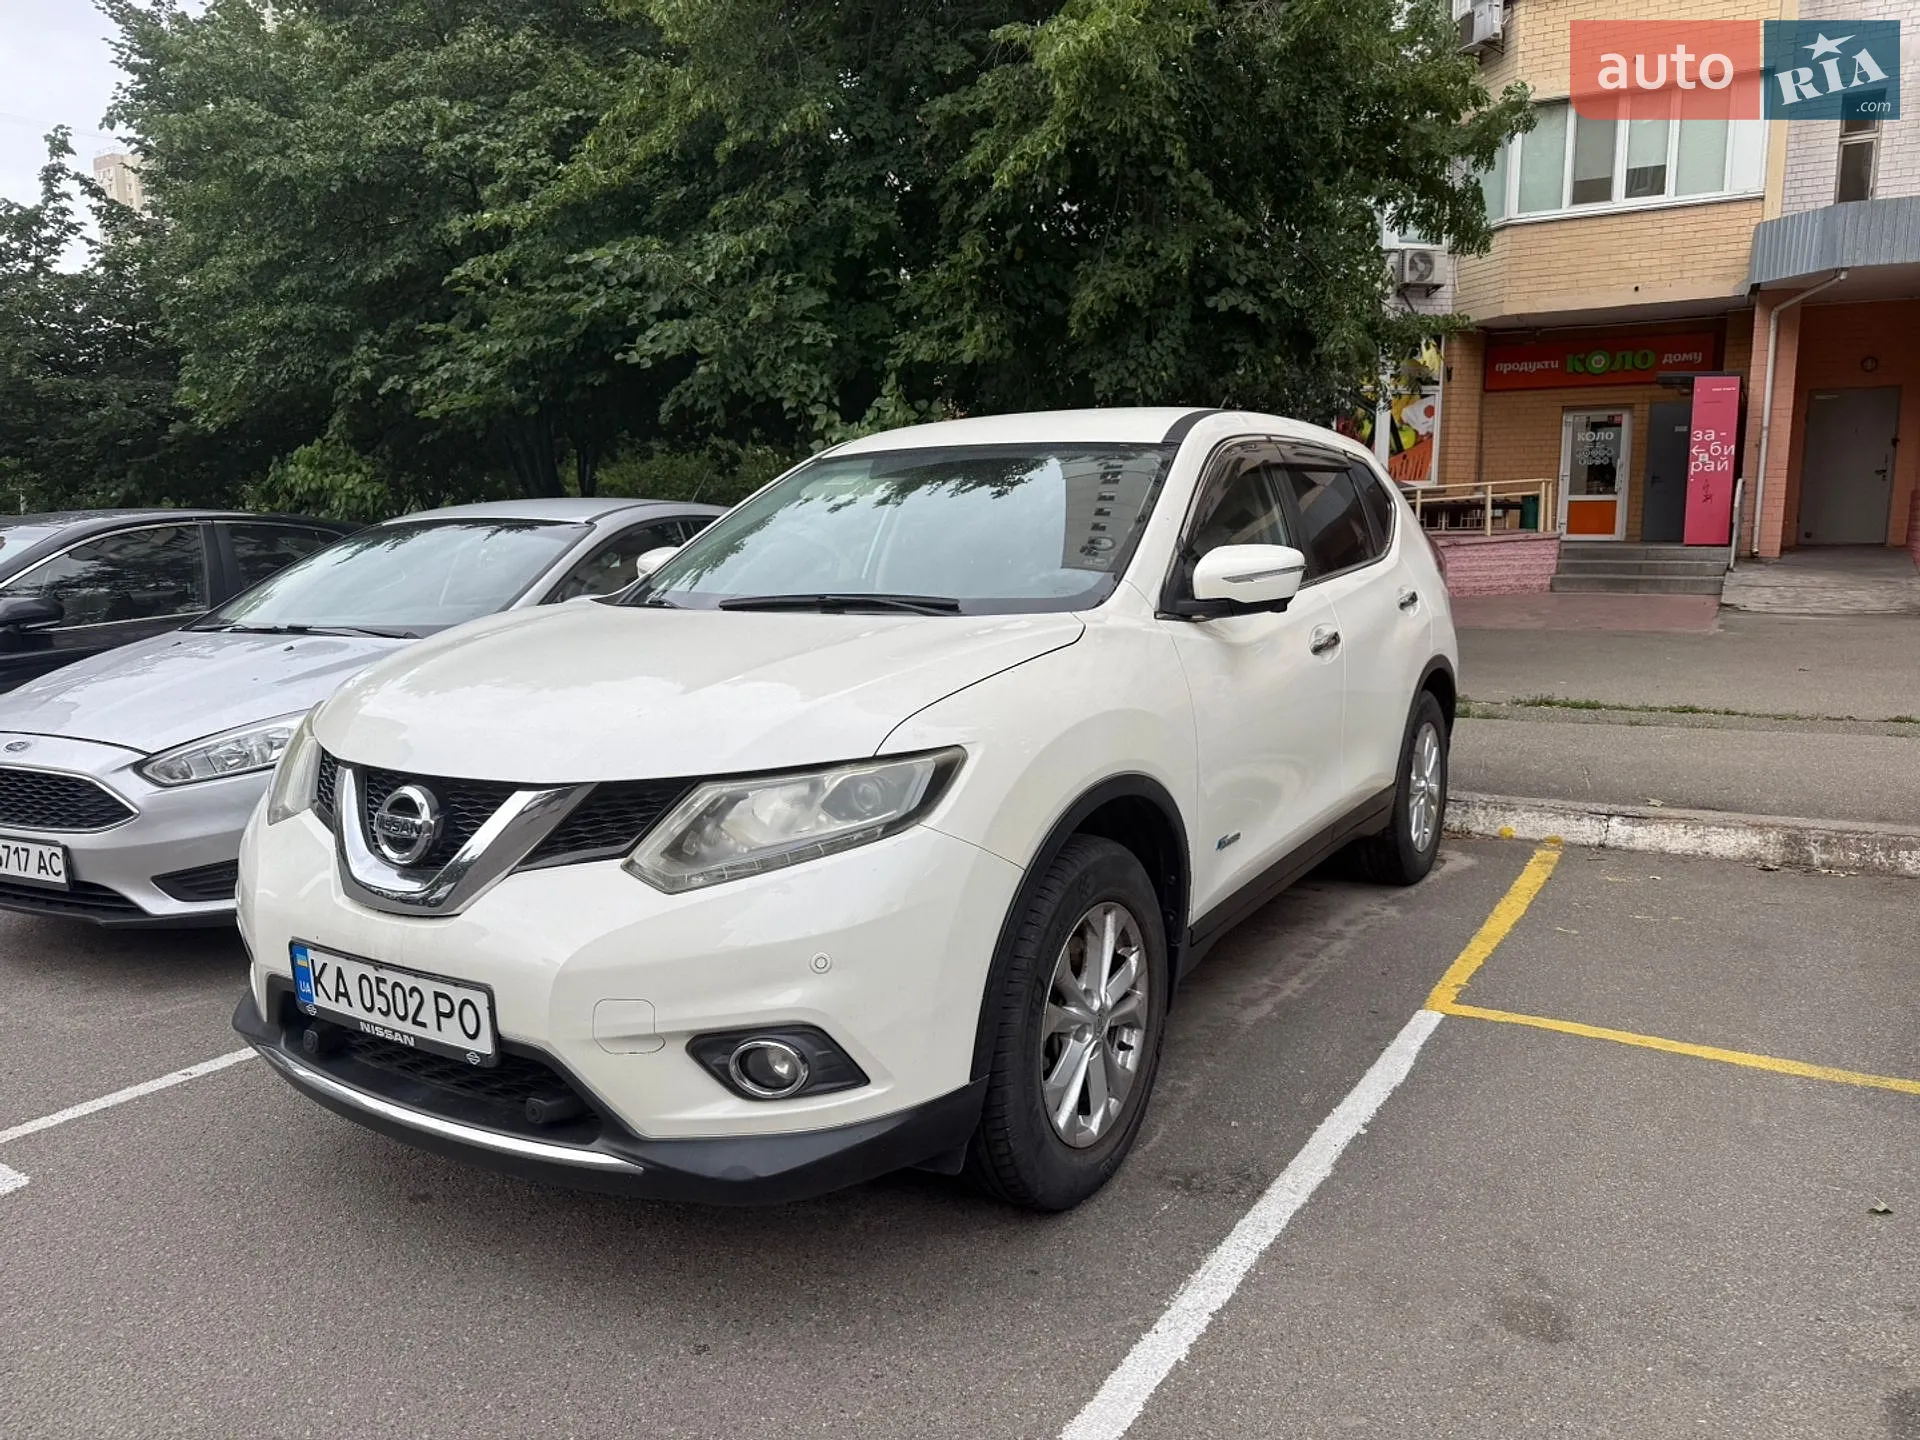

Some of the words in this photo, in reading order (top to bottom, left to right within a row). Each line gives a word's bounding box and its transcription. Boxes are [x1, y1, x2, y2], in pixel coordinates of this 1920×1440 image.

[1495, 359, 1559, 374] продукти
[1662, 351, 1703, 364] дому
[1710, 441, 1735, 456] би
[1690, 456, 1729, 475] рай
[0, 845, 30, 873] 717
[37, 850, 62, 877] AC
[300, 981, 312, 994] UA
[310, 958, 353, 1008] KA
[358, 973, 427, 1028] 0502
[433, 990, 481, 1041] PO
[359, 1021, 415, 1047] NISSAN
